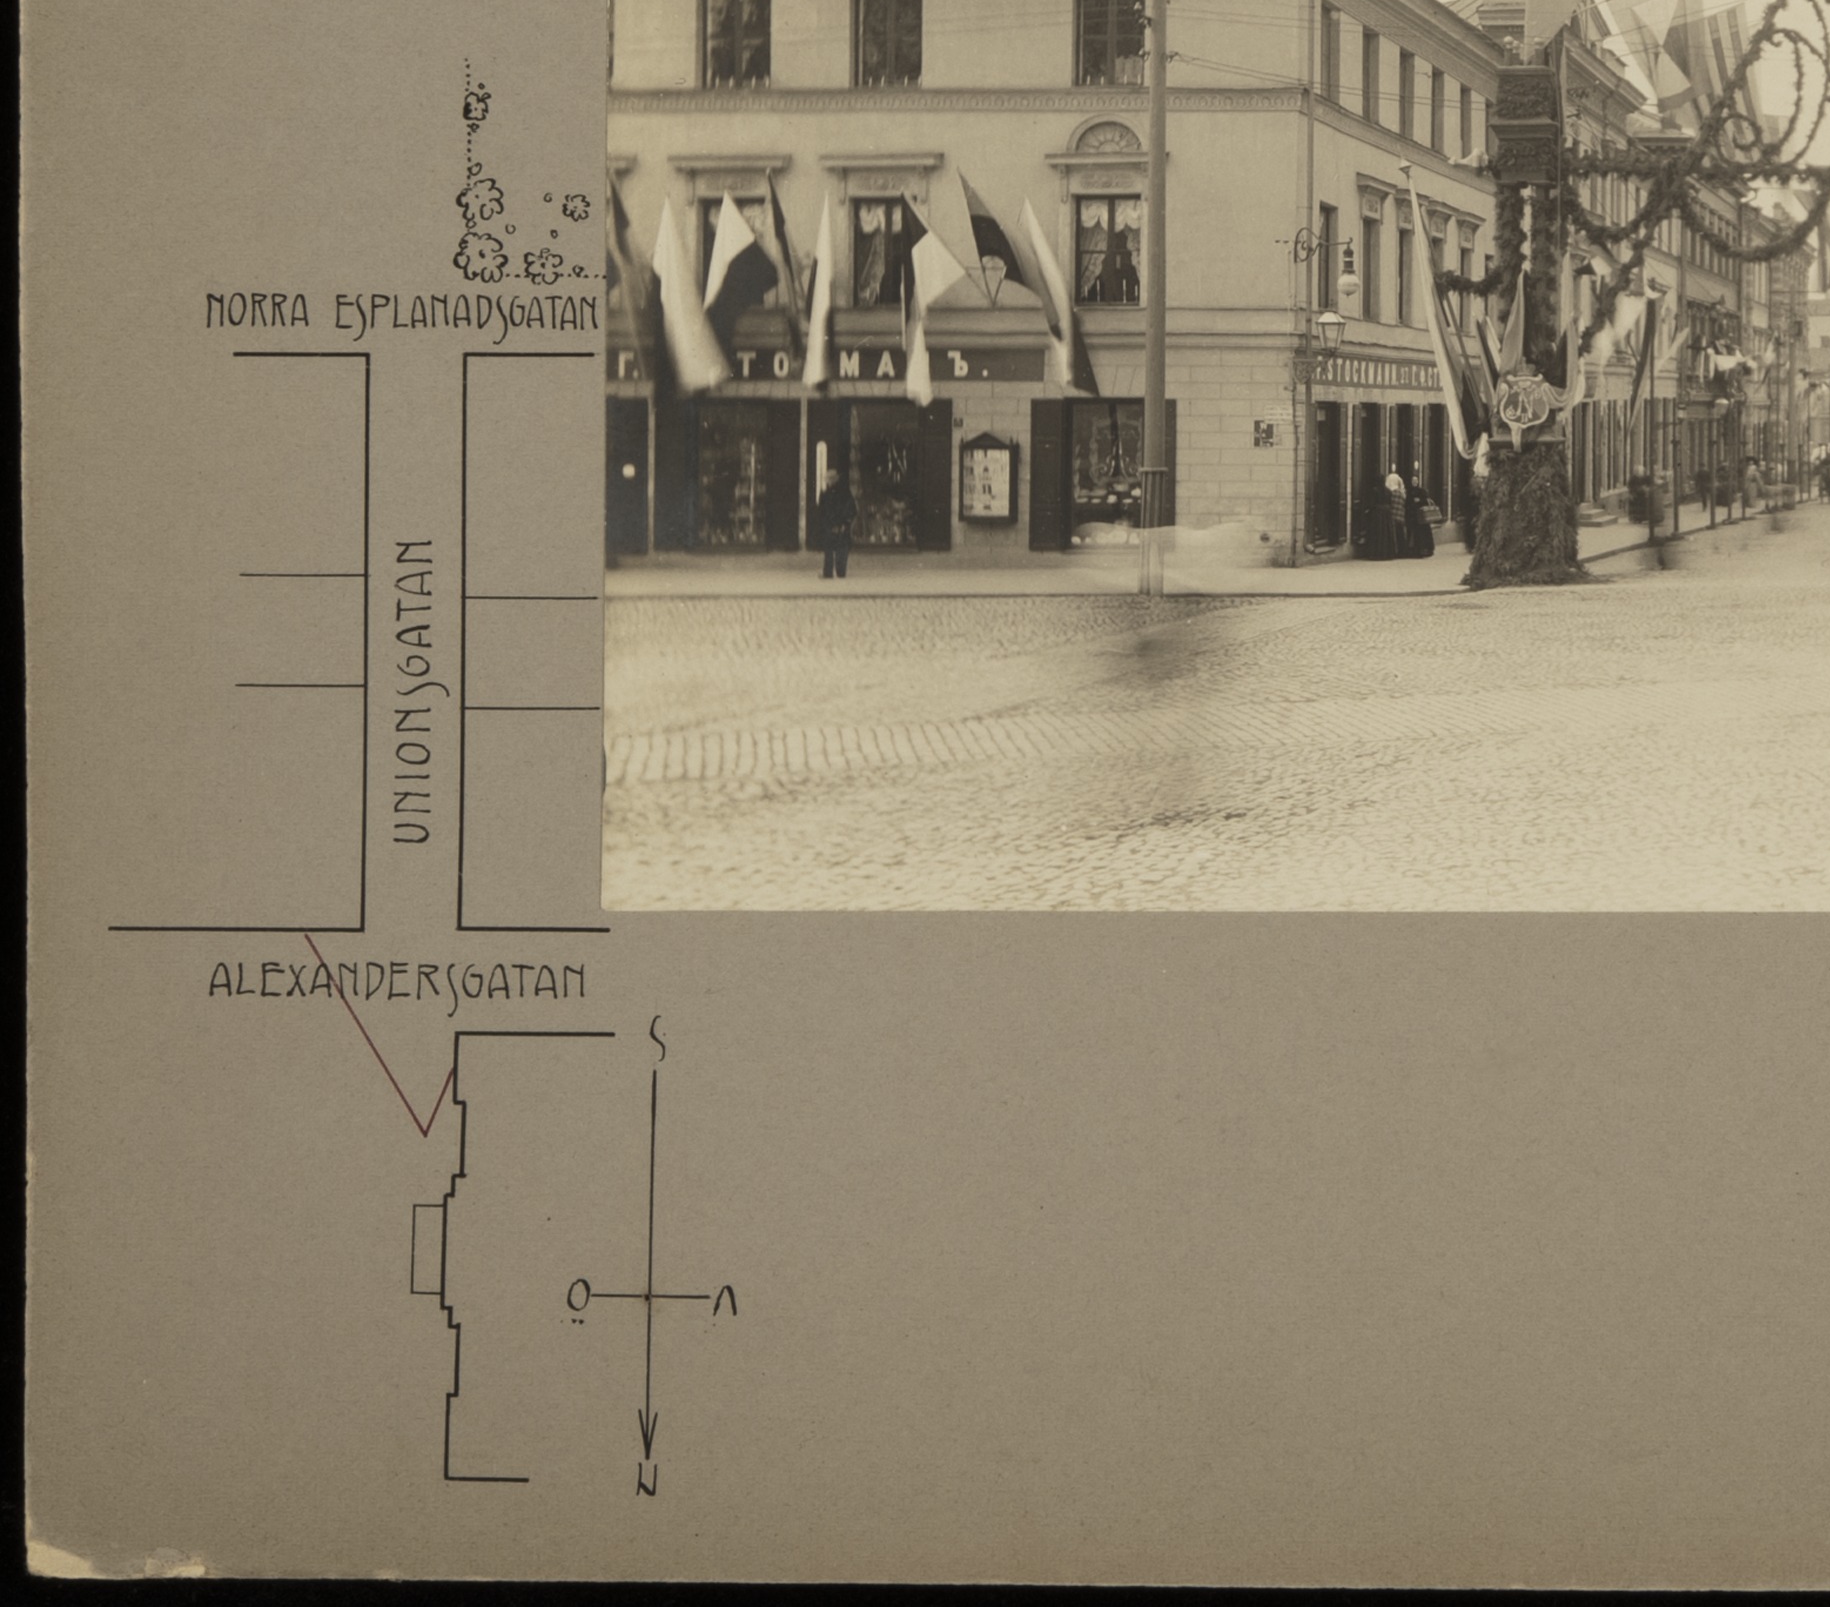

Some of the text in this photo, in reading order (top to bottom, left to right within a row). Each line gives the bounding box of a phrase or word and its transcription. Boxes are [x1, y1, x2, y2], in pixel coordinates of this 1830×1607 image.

[206, 292, 598, 344] NORRA ESPLANADSGATAN
[393, 540, 450, 844] UNIONSGATAN
[209, 960, 585, 1018] ALEXANDERSGATAN
[636, 1462, 658, 1497] N
